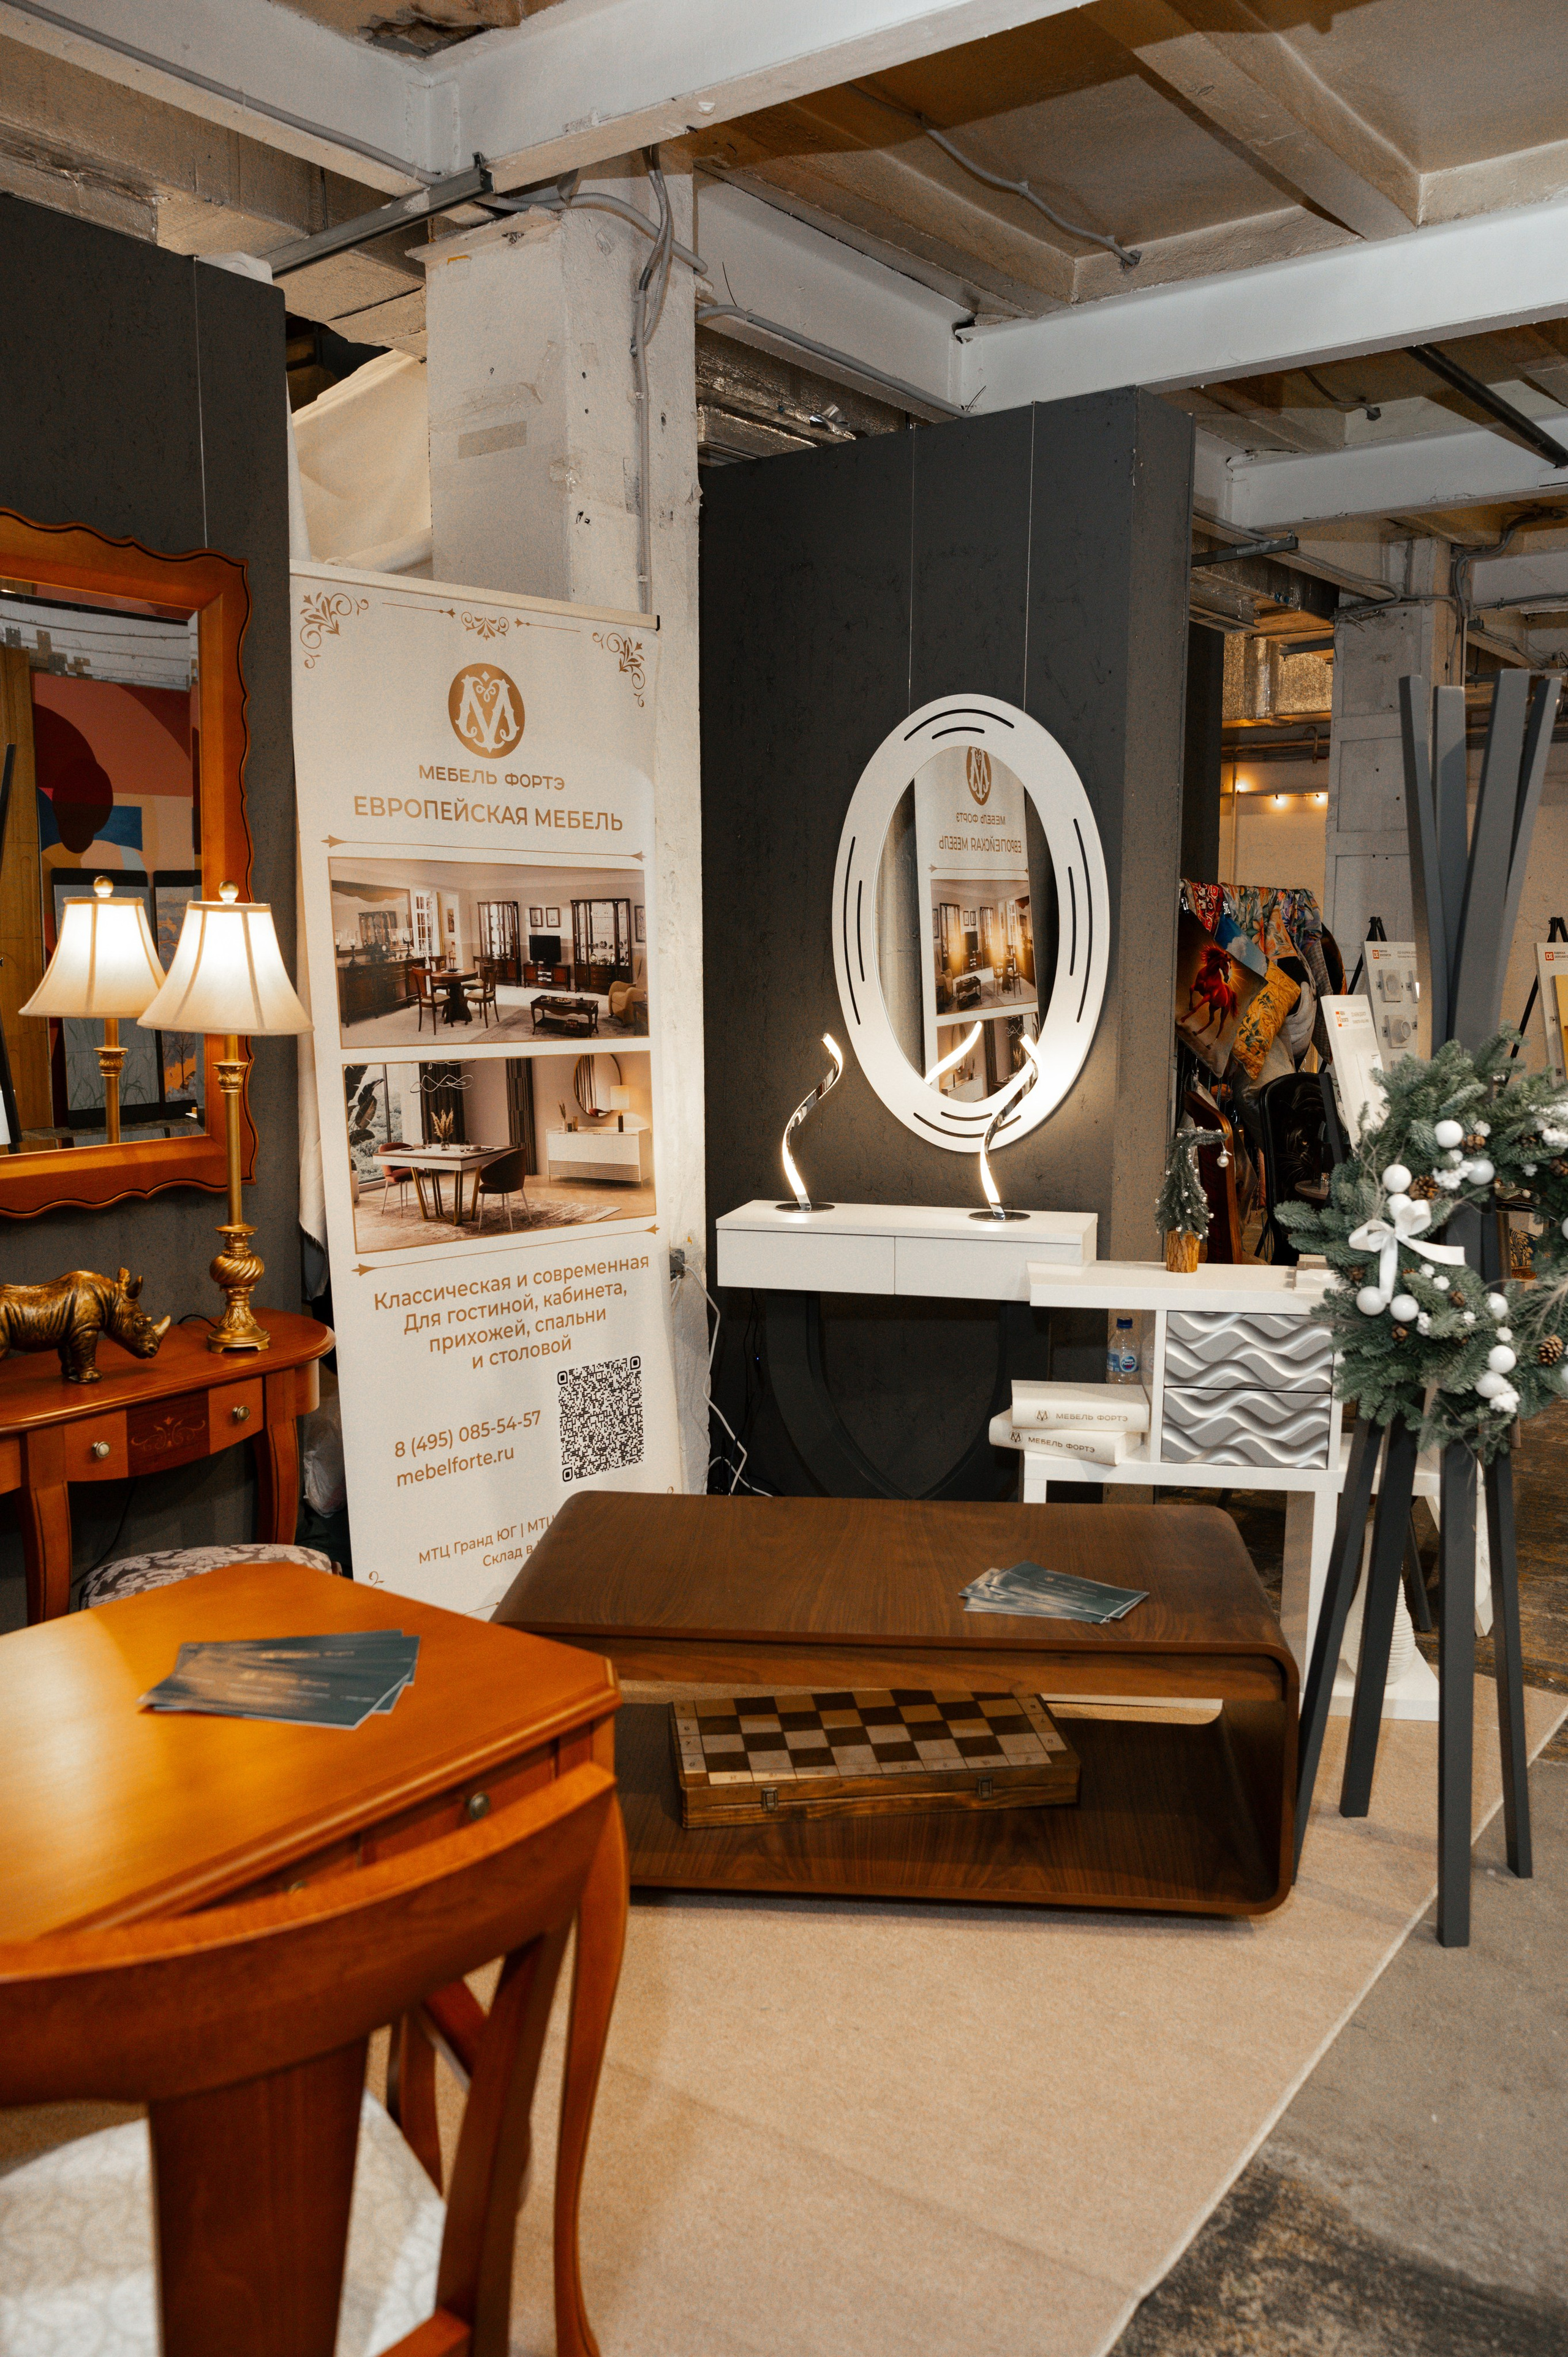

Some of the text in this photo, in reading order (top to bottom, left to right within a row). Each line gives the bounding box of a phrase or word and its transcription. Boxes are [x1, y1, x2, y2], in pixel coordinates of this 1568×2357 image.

[418, 764, 565, 791] МЕБЕЛЬ ФОРТЭ
[353, 796, 624, 832] ЕВРОПЕЙСКАЯ МЕБЕЛЬ
[374, 1256, 649, 1311] Классическая и современная
[404, 1282, 627, 1335] Для гостиной, кабинета,
[429, 1307, 606, 1352] прихожей, спальни
[472, 1333, 572, 1370] и столовой
[394, 1409, 541, 1458] 8 (495) 085-54-57
[1028, 1436, 1096, 1453] МЕБЕЛЬ ФОРТЭ
[396, 1447, 514, 1488] mebelforte.ru
[418, 1544, 451, 1564] МТЦ
[454, 1534, 494, 1555] Гранд
[497, 1525, 517, 1542] ЮГ
[483, 1545, 533, 1567] Склад в
